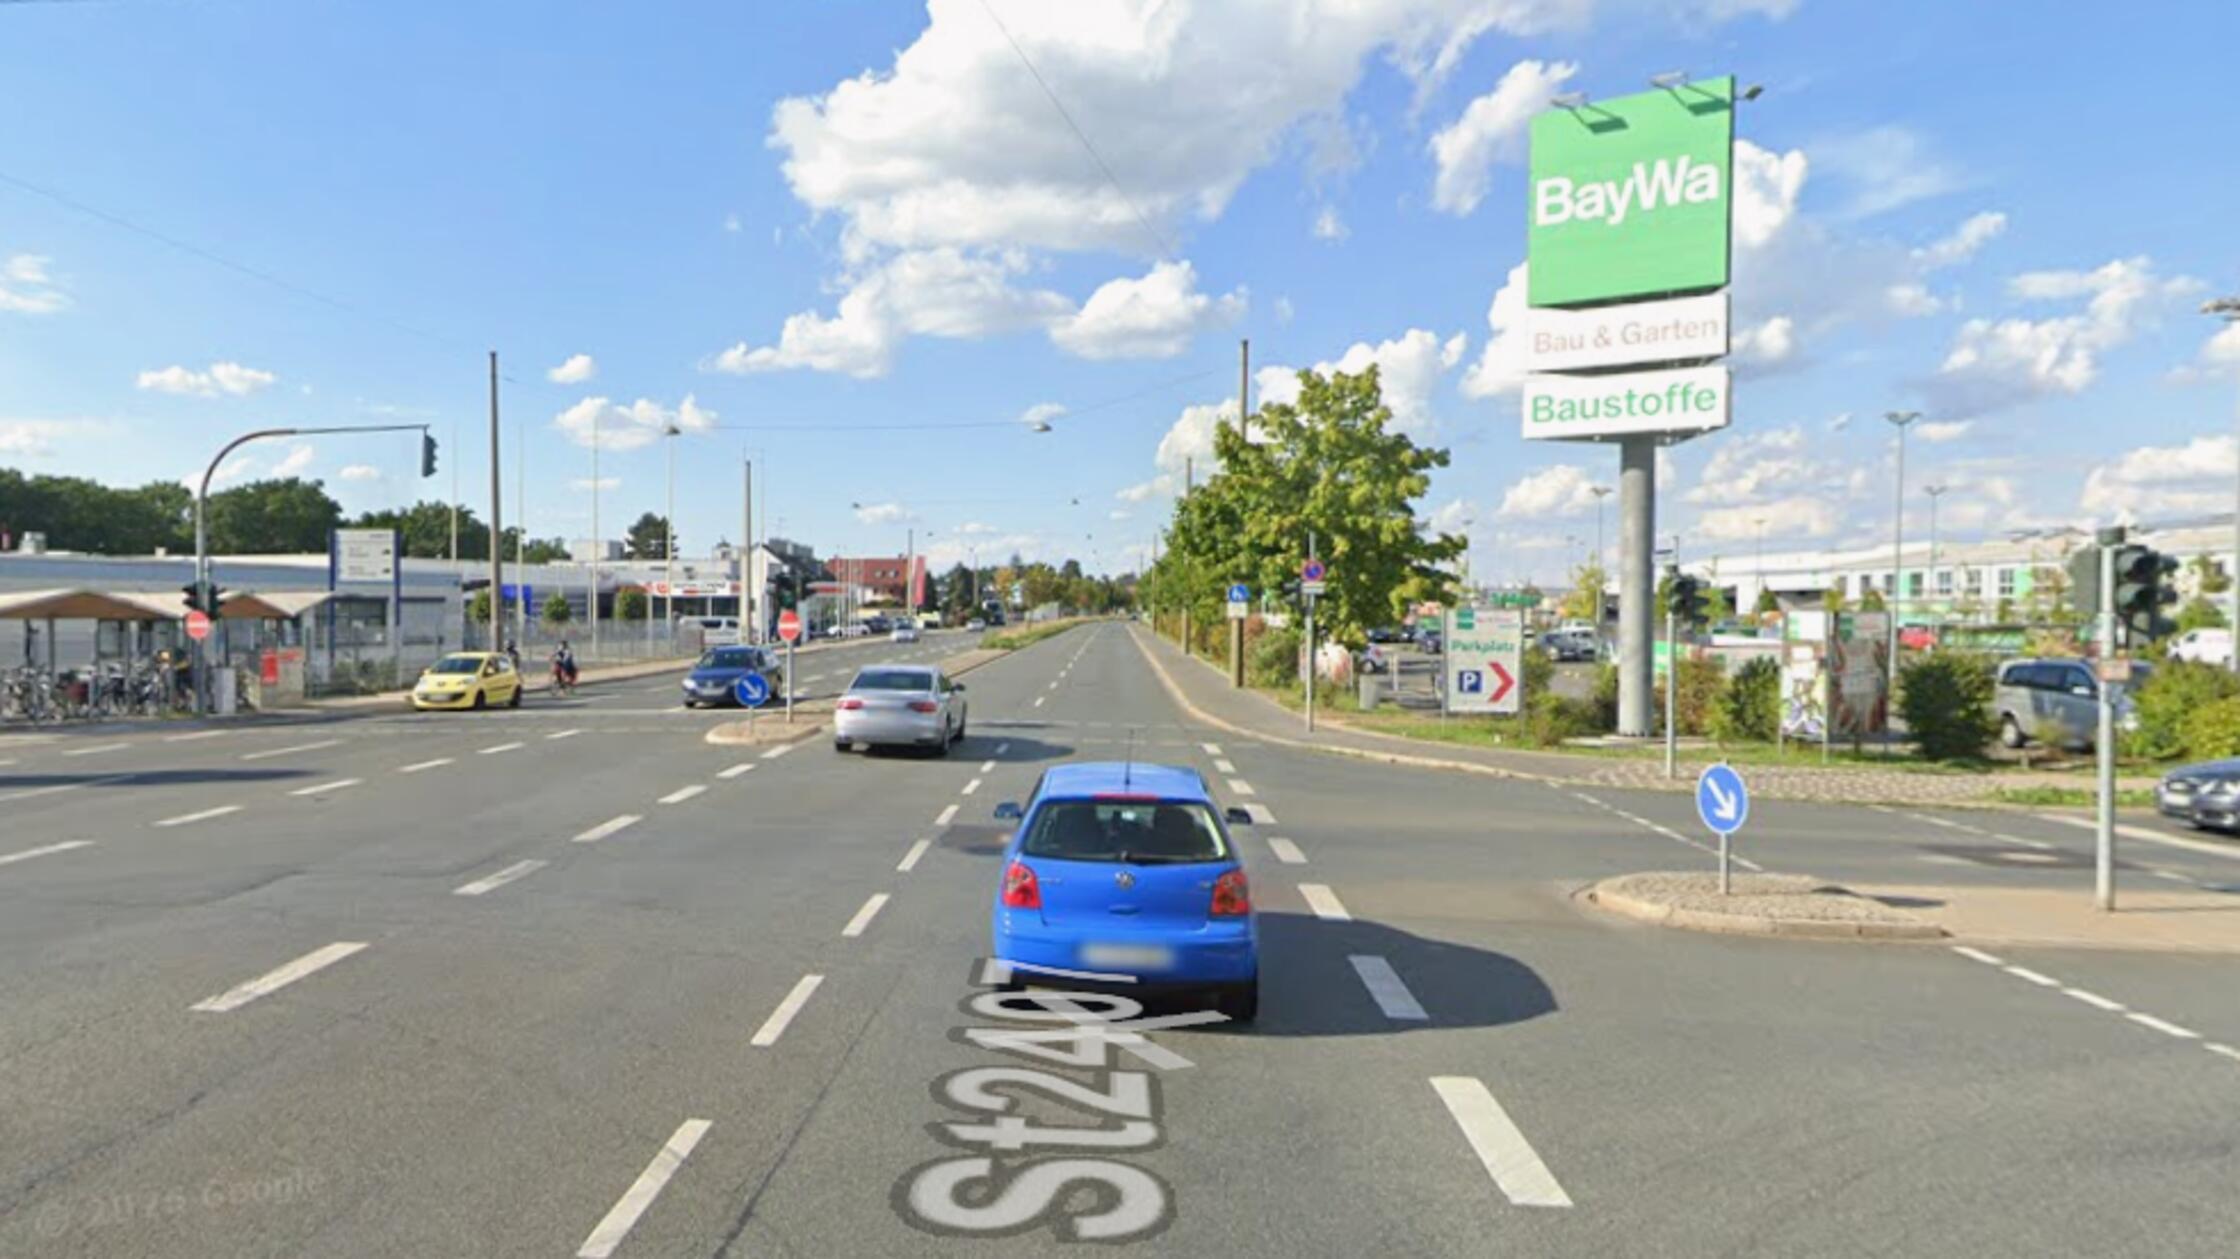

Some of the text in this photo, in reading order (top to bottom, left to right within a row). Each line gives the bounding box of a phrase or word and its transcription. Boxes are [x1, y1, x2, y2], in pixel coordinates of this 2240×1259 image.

[1536, 154, 1720, 226] BayWa
[1534, 316, 1719, 354] Bau & Garten
[1531, 382, 1717, 424] Baustoffe
[1450, 639, 1515, 655] Parkplatz
